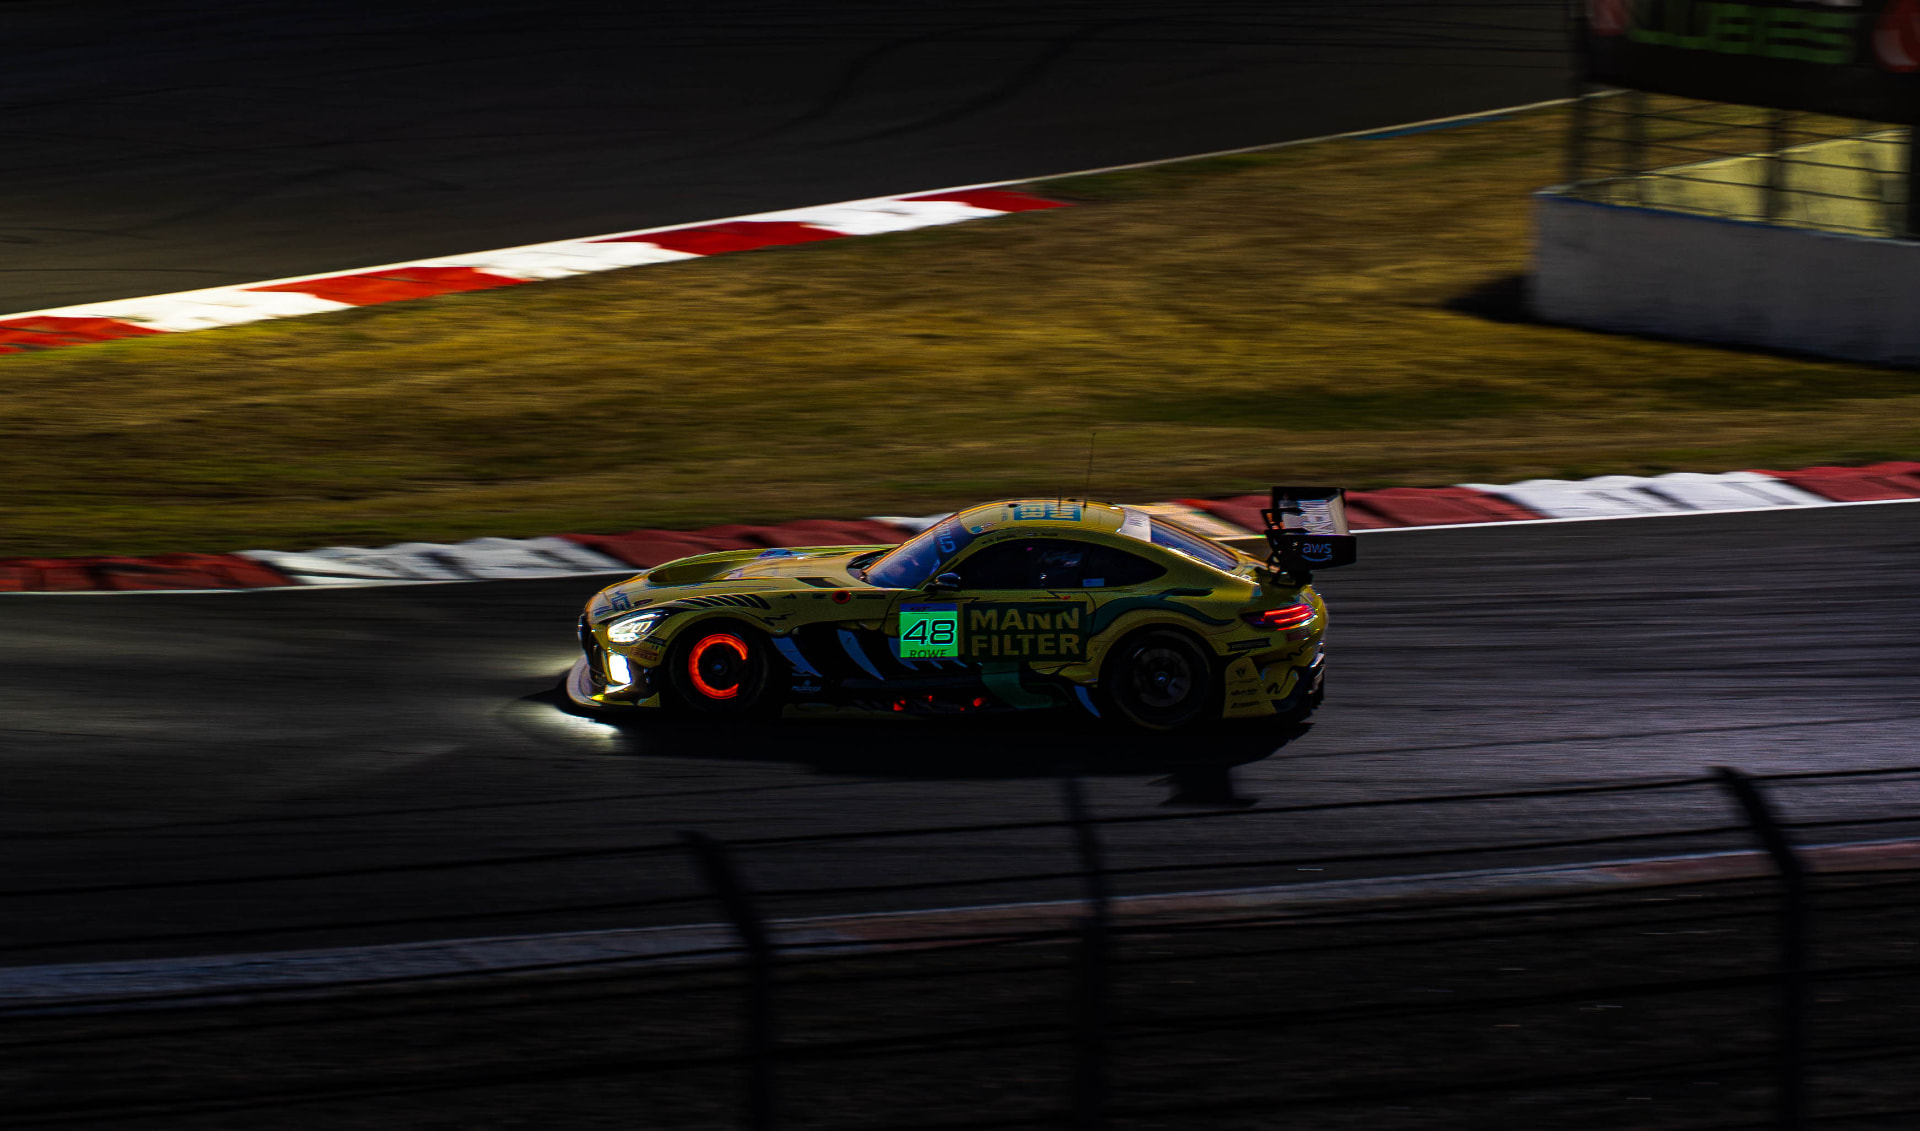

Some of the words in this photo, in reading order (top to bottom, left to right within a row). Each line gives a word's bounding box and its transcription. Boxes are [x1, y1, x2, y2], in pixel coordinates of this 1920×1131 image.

[1301, 542, 1333, 554] aws
[969, 607, 1080, 631] MANN
[902, 619, 955, 645] 48
[970, 633, 1081, 657] FILTER
